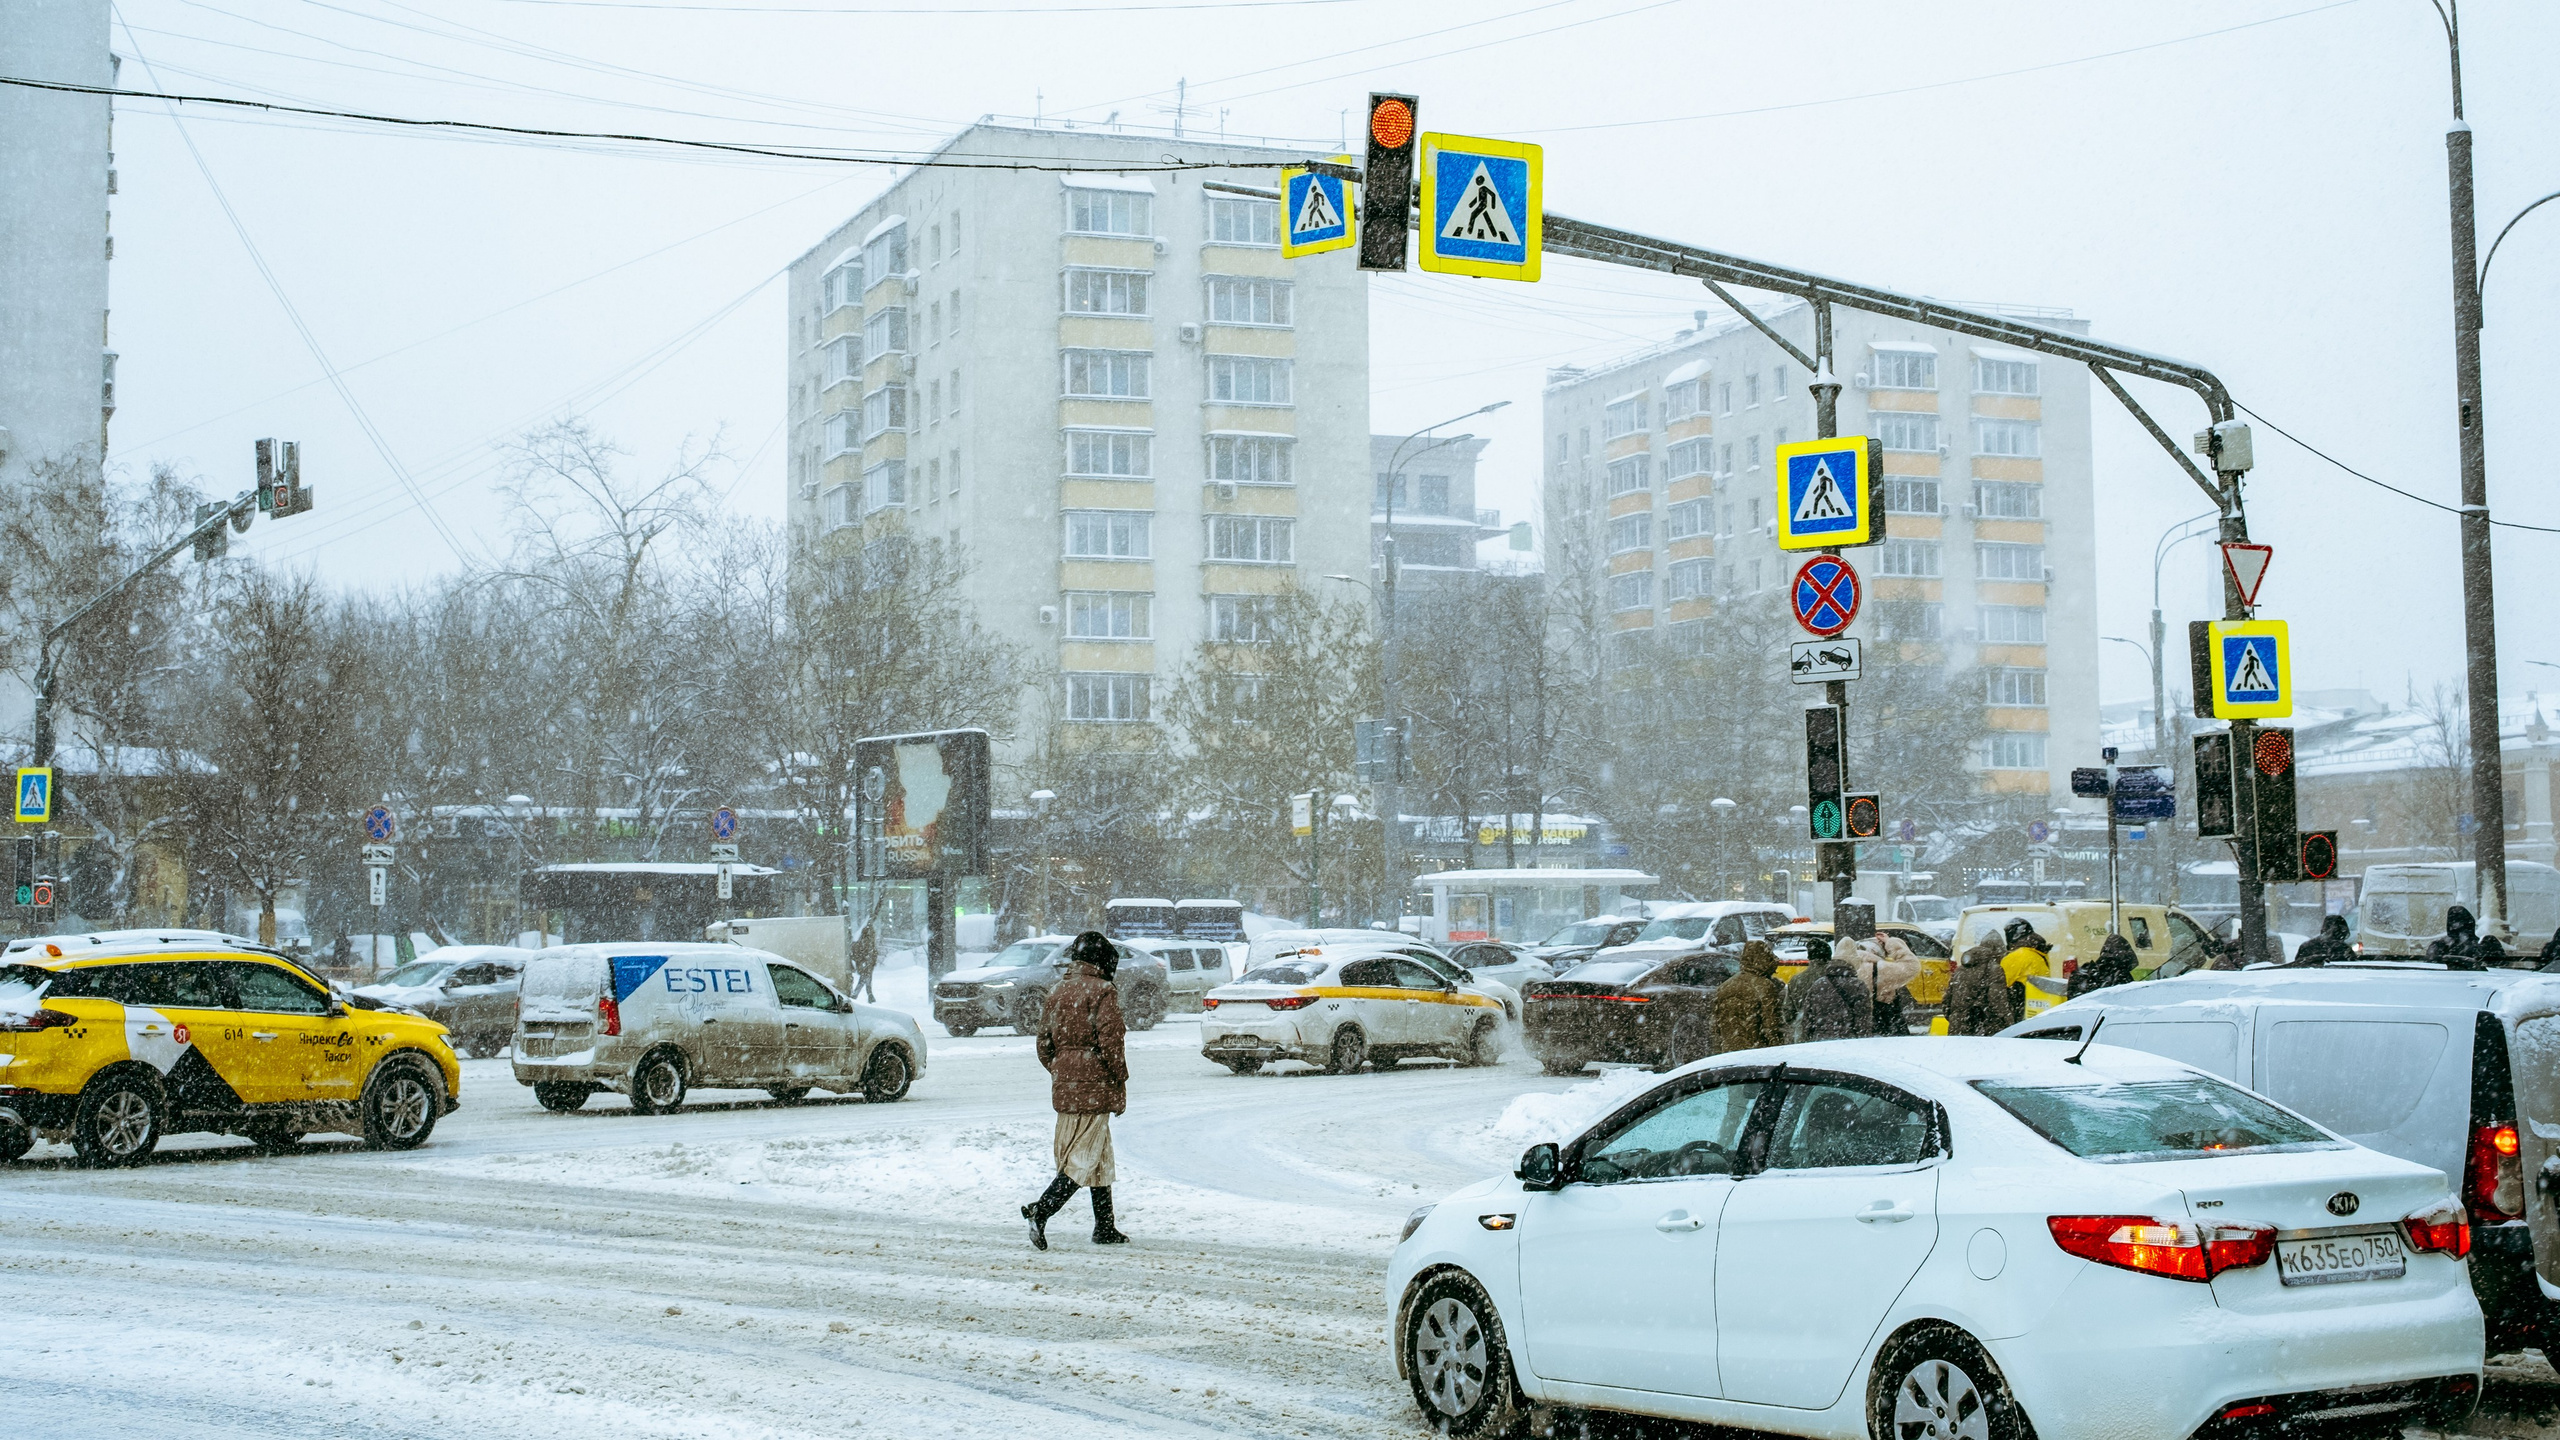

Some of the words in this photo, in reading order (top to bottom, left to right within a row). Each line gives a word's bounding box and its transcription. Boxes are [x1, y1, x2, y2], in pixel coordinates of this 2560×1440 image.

[1542, 828, 1587, 838] BAKERY
[177, 1028, 187, 1044] Я
[224, 1028, 243, 1040] 614
[299, 1032, 337, 1046] Яндекс
[337, 1031, 354, 1047] Go
[324, 1049, 352, 1062] Такси
[2196, 1200, 2224, 1209] RIO
[2332, 1195, 2358, 1212] KIA
[2286, 1243, 2365, 1273] К635ЕО
[2364, 1237, 2394, 1259] 750
